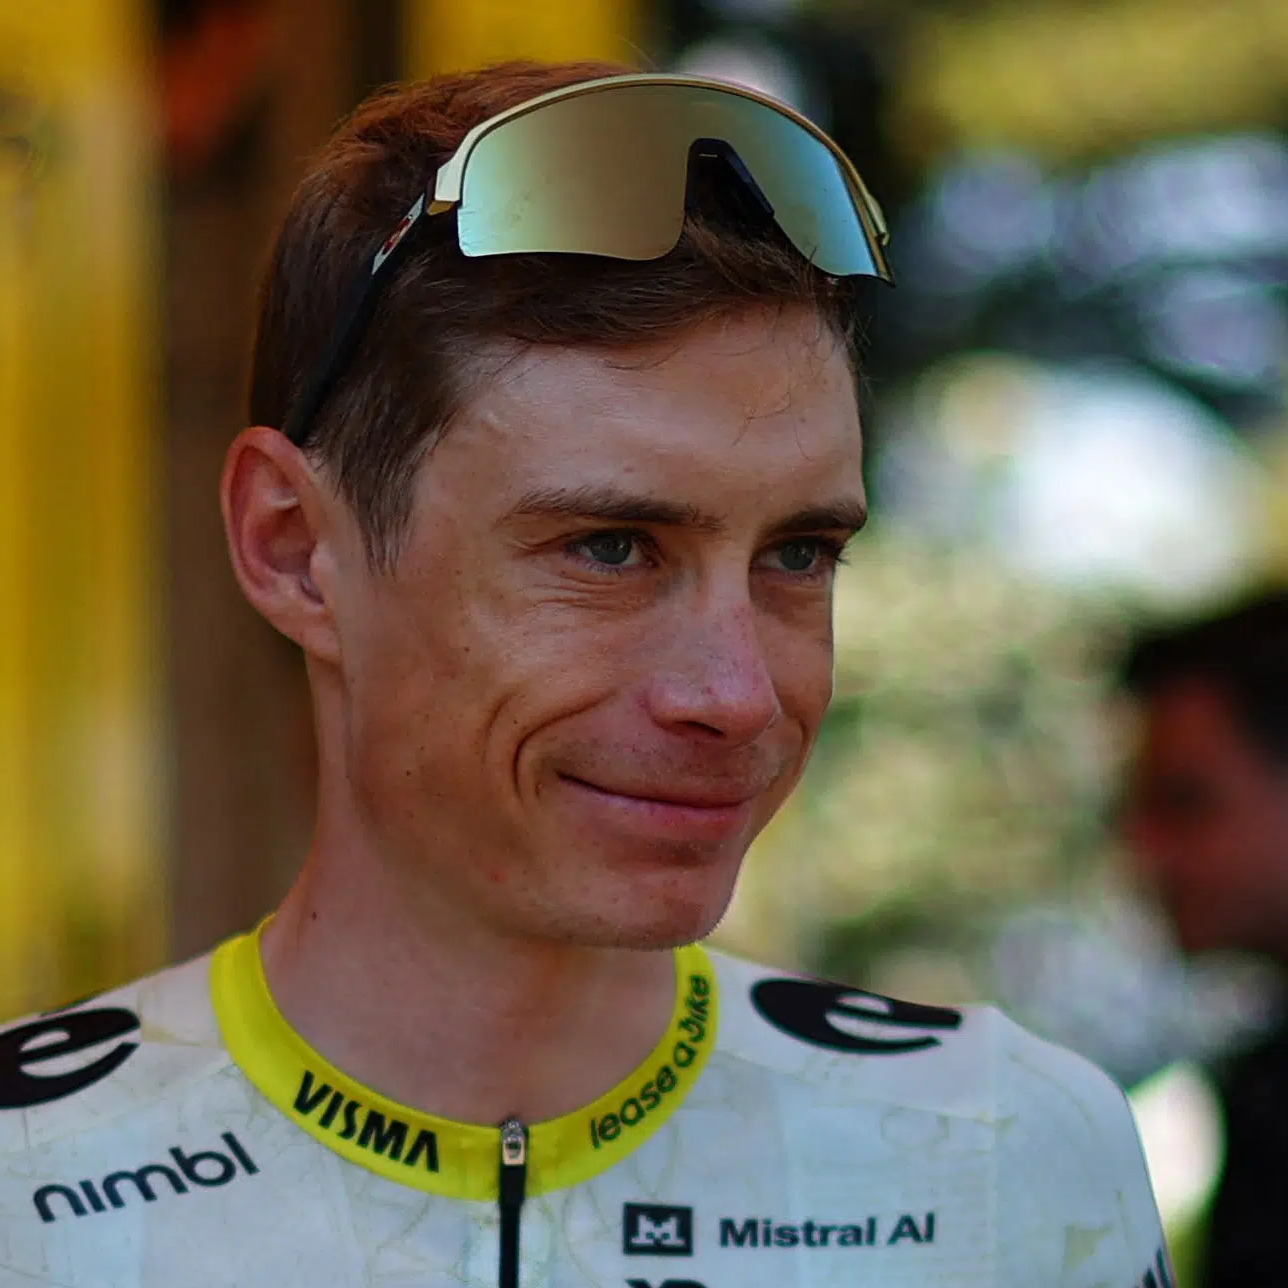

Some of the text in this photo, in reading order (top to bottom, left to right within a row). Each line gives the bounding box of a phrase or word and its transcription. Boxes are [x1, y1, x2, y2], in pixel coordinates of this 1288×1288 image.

[293, 1070, 440, 1173] VISMA
[589, 1065, 678, 1149] lease
[33, 1132, 259, 1223] nimbl
[720, 1212, 936, 1248] Mistral AI
